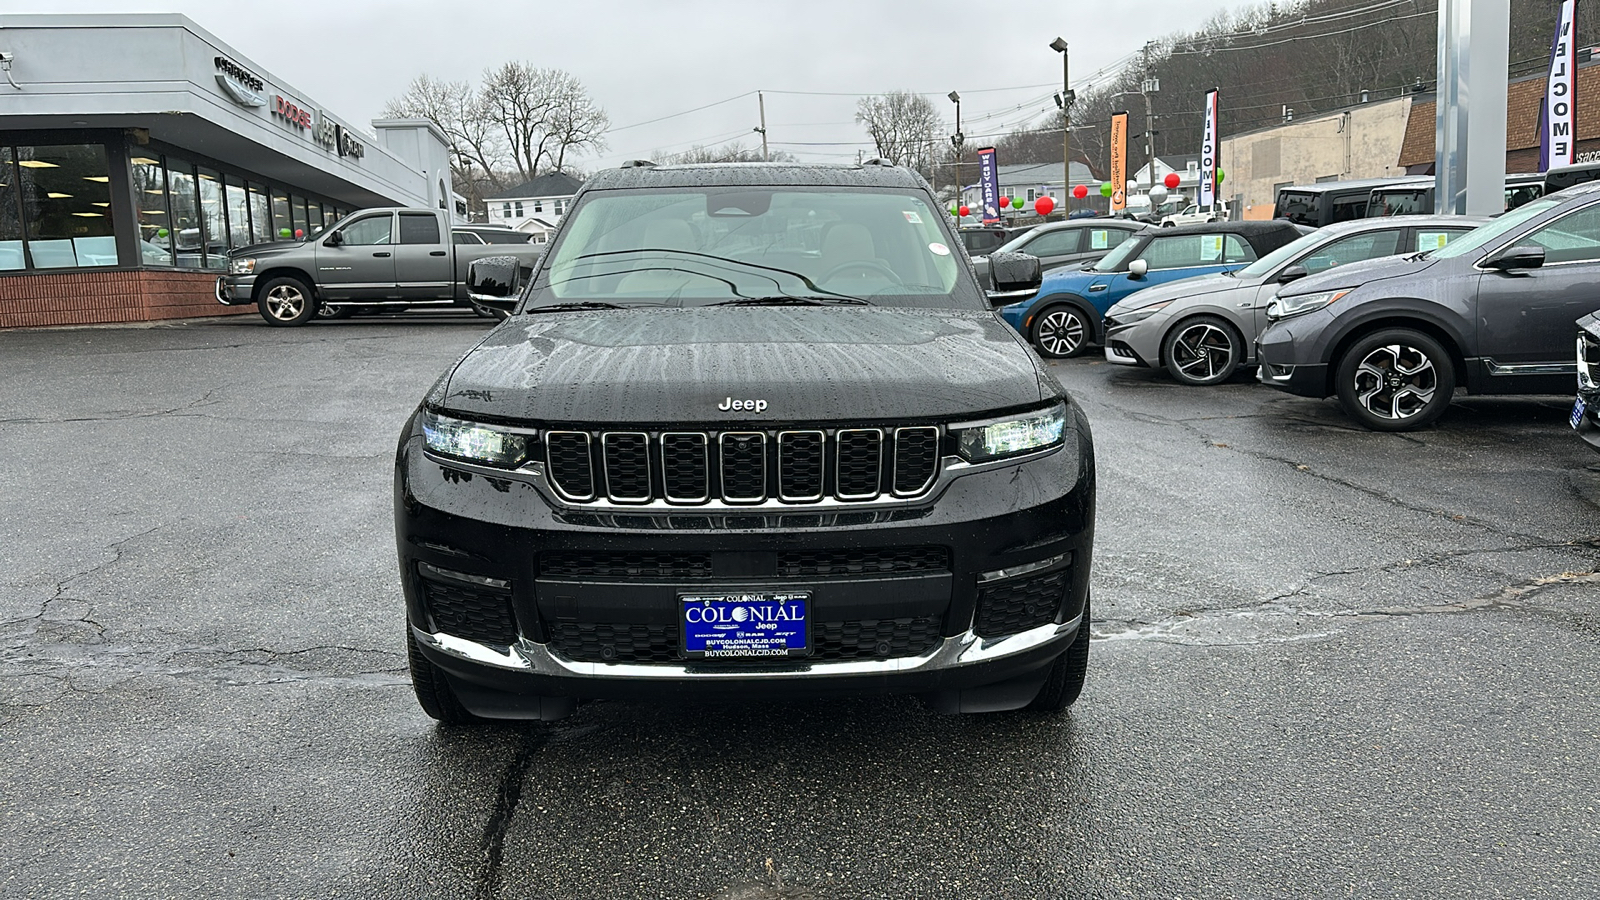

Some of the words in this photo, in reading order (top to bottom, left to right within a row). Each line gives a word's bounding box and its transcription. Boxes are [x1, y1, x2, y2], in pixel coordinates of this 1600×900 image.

[274, 95, 311, 130] DODGE
[718, 397, 768, 413] Jeep
[726, 595, 766, 603] COLONIAL
[685, 605, 805, 623] COLONIAL
[755, 622, 778, 631] Jeep
[704, 649, 789, 657] BUYCOLONIALCJD.COM
